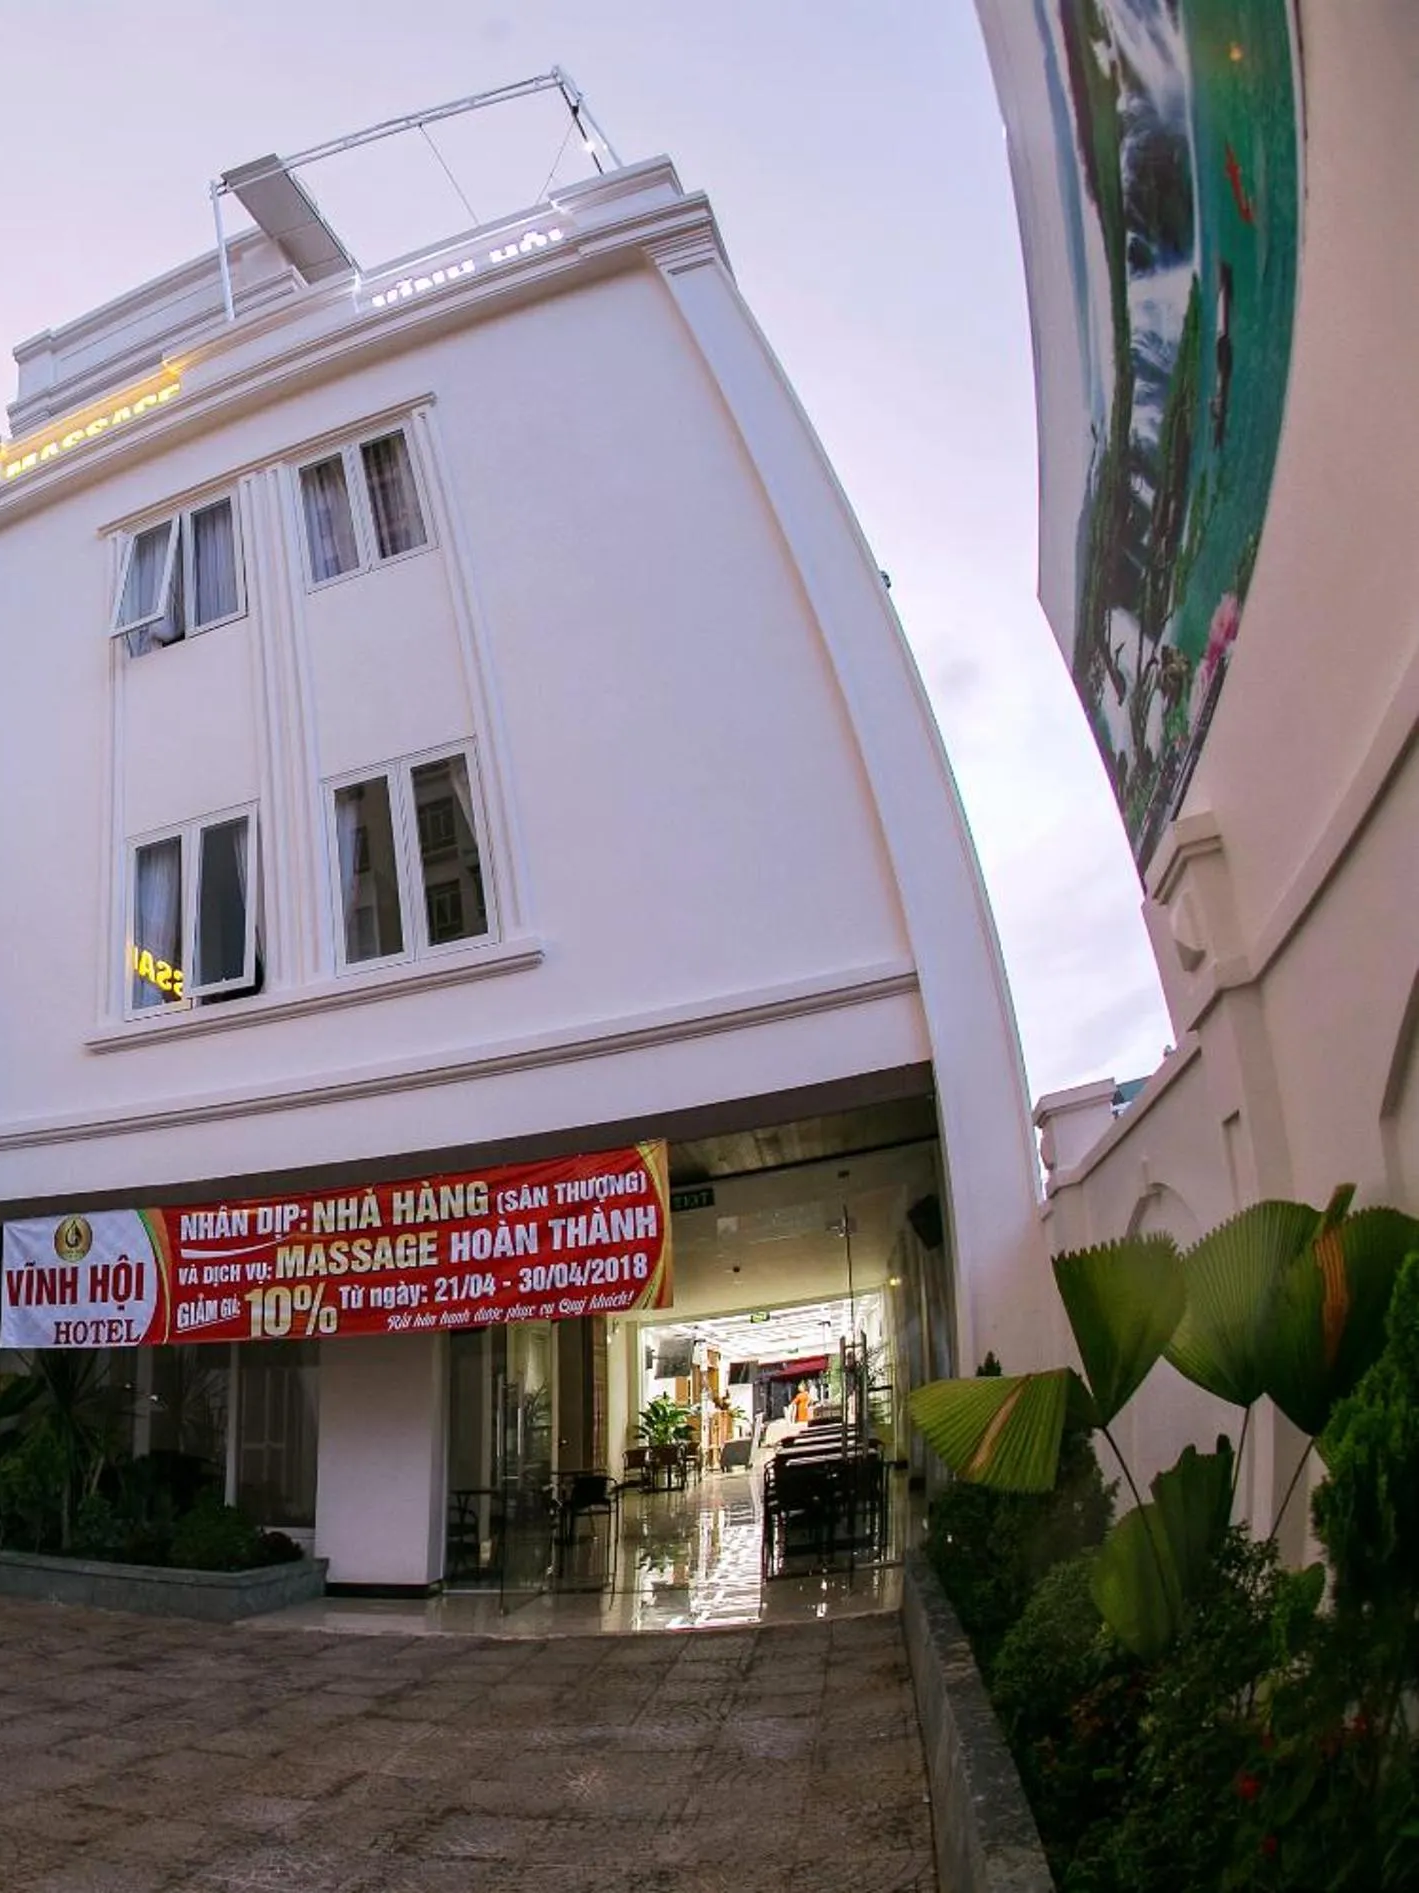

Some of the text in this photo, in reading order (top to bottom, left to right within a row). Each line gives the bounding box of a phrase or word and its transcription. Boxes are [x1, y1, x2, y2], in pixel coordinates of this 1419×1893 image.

[180, 1170, 648, 1242] NHÂN DỊP: NHÀ HÀNG (SÂN THƯỢNG)
[178, 1204, 657, 1287] VÀ DỊCH VỤ: MASSAGE HOÀN THÀNH
[5, 1254, 145, 1311] VĨNH HỘI
[177, 1293, 219, 1329] GIẢM
[244, 1282, 337, 1337] 10%
[339, 1284, 366, 1310] Từ
[370, 1280, 429, 1310] ngày:
[434, 1273, 497, 1303] 21/04
[518, 1252, 648, 1293] 30/04/2018
[53, 1319, 142, 1345] HOTEL
